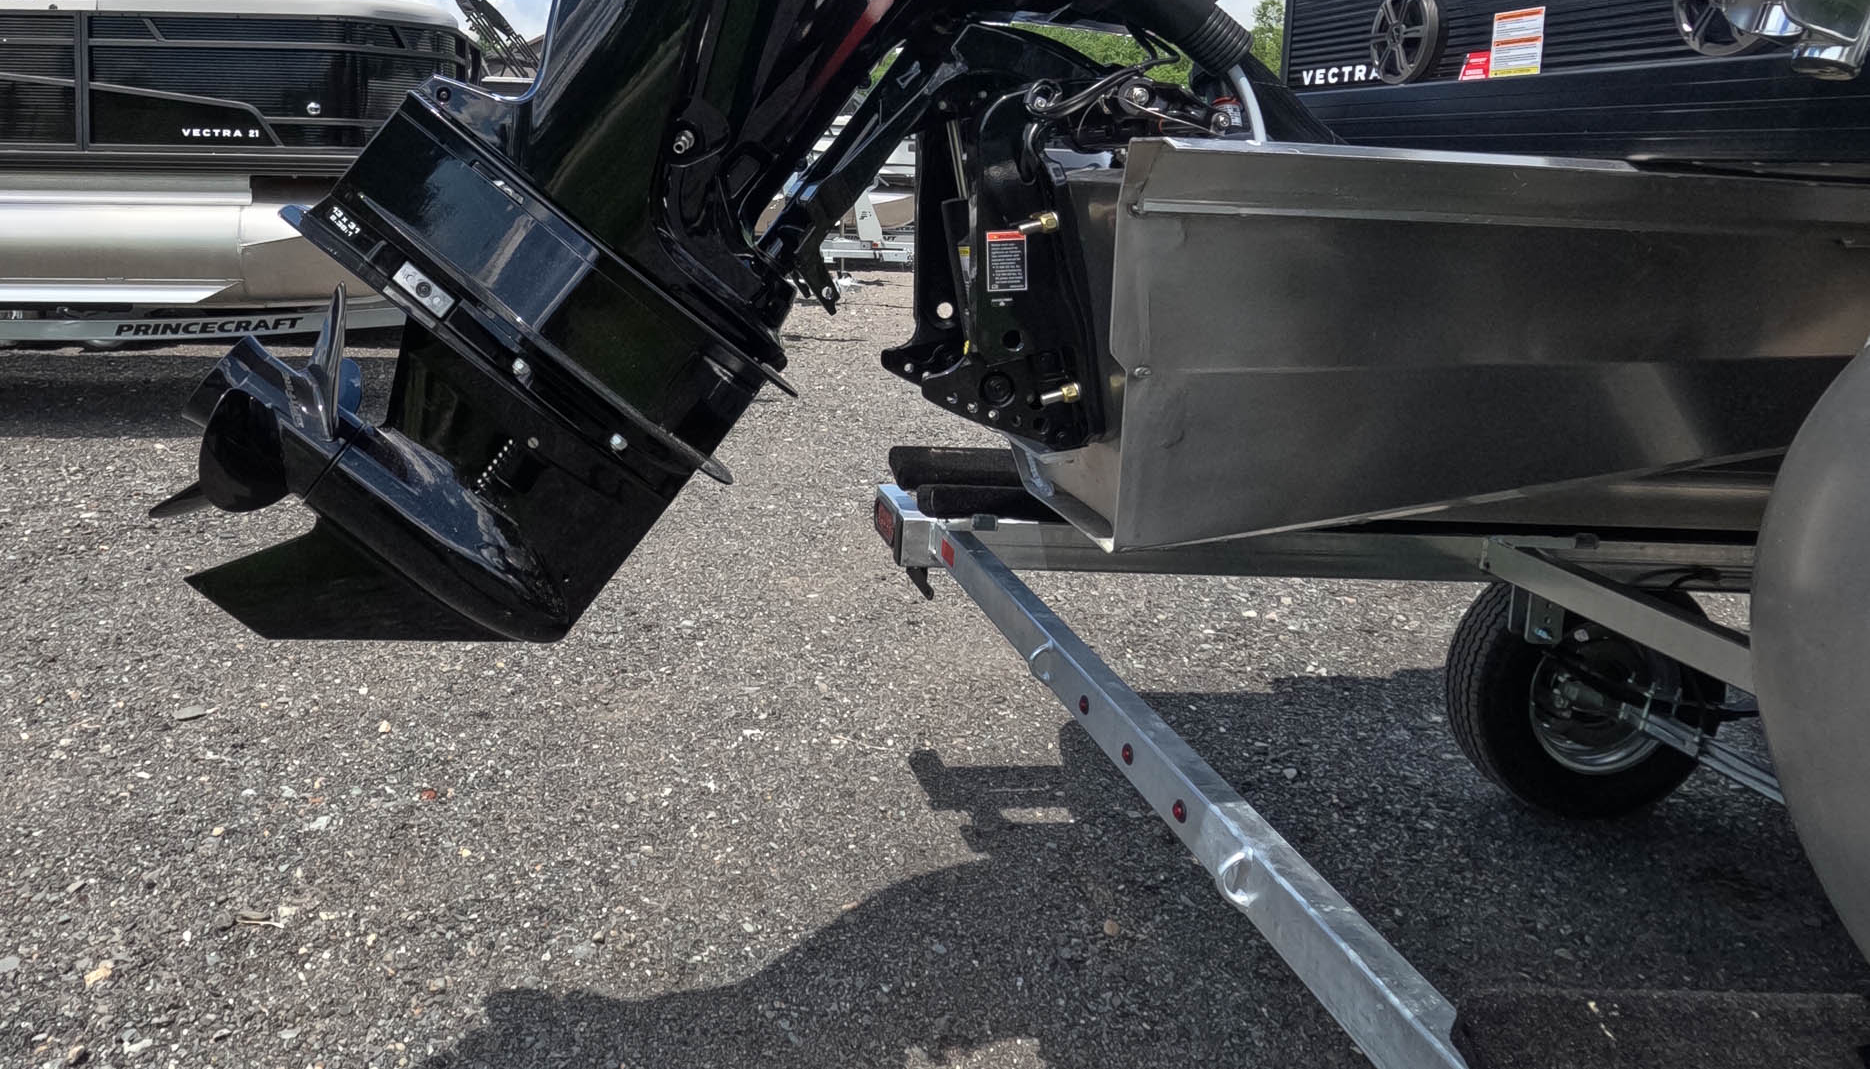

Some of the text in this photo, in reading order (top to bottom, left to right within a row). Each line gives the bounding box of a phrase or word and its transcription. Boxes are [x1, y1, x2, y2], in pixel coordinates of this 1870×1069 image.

[1302, 64, 1381, 86] VECTRA
[181, 128, 260, 138] VECTRA 21
[115, 317, 304, 336] PRINCECRAFT
